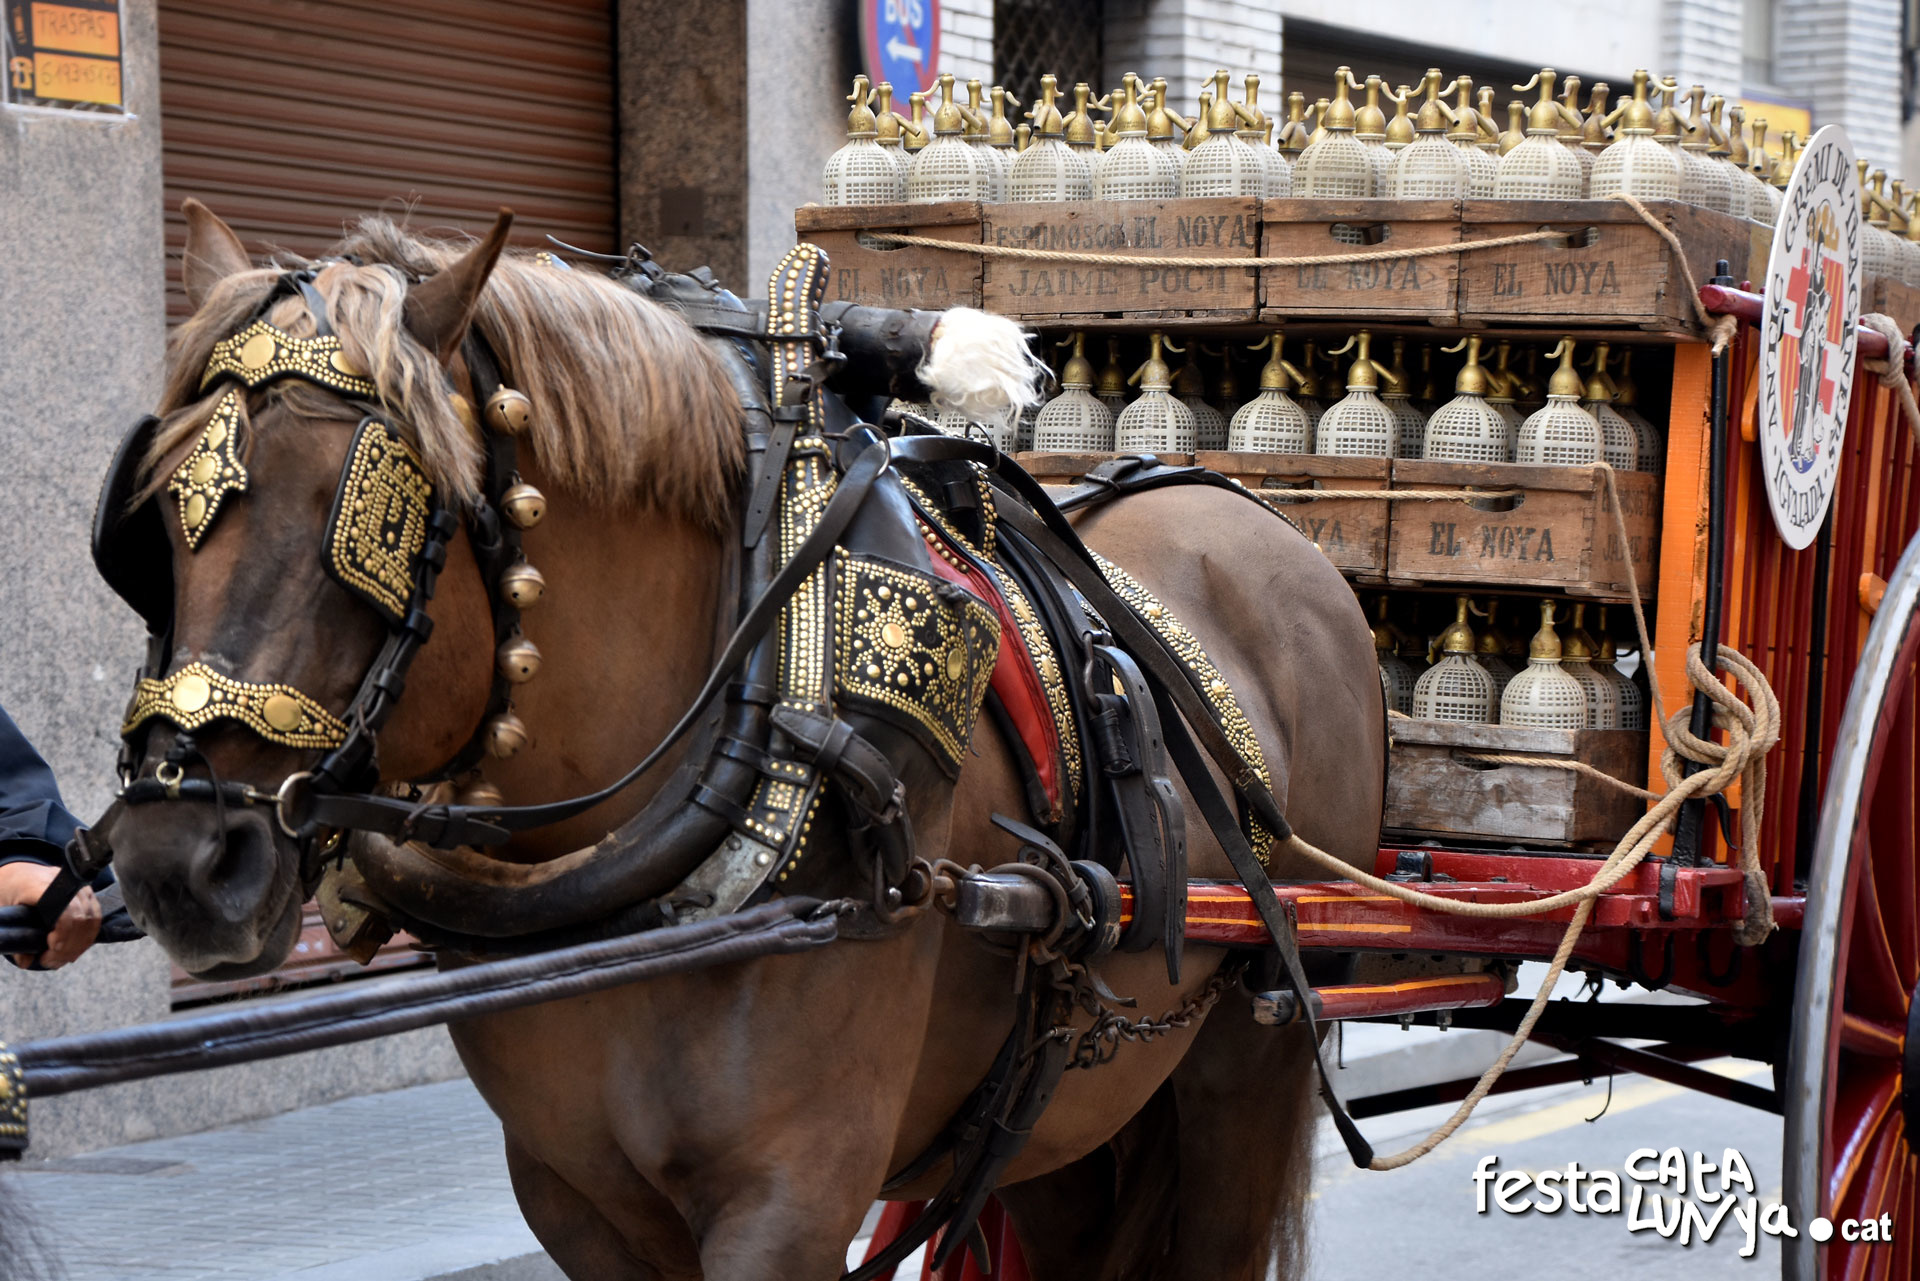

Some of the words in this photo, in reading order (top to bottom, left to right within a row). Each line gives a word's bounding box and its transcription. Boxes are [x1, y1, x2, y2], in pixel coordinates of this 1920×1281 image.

[885, 0, 924, 29] BUS
[1785, 142, 1834, 254] GREMI
[1134, 215, 1162, 249] EL
[1176, 214, 1252, 249] NOYA
[837, 267, 867, 301] EL
[880, 265, 951, 300] NOYA
[1008, 267, 1119, 297] JAIME
[1297, 261, 1327, 289] EL
[1346, 256, 1421, 290] NOYA
[1491, 262, 1522, 296] EL
[1544, 261, 1621, 296] NOYA
[1429, 521, 1462, 557] EL
[1480, 525, 1555, 561] NOYA
